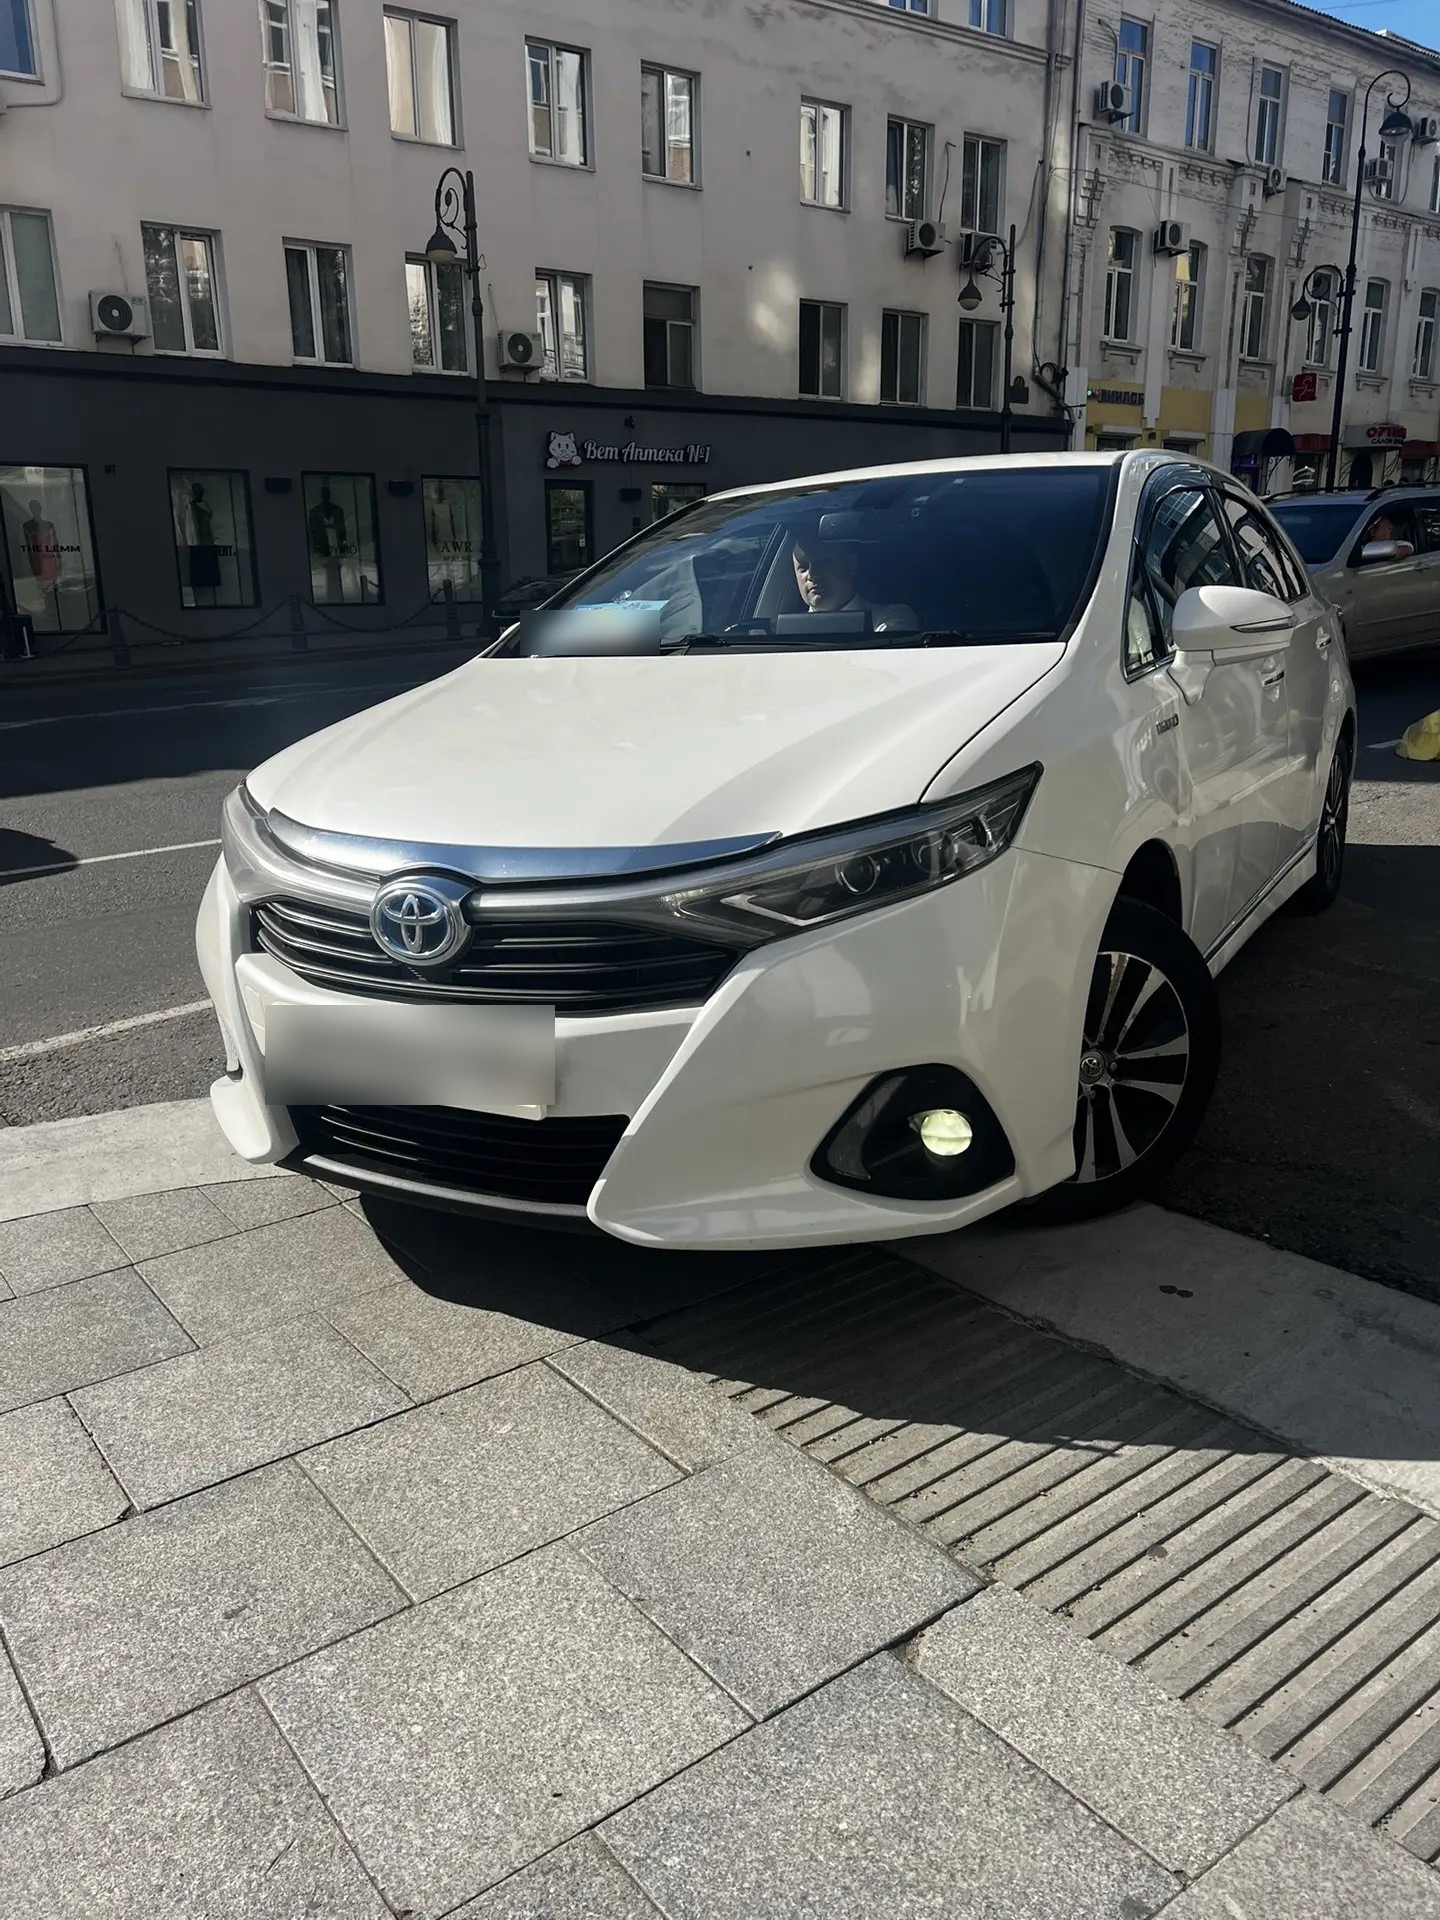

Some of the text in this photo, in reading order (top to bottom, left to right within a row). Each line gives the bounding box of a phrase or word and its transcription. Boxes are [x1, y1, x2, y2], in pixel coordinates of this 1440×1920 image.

[583, 439, 711, 464] Вет Аптека №1
[20, 545, 81, 553] THE LEMM
[441, 541, 473, 553] AWR
